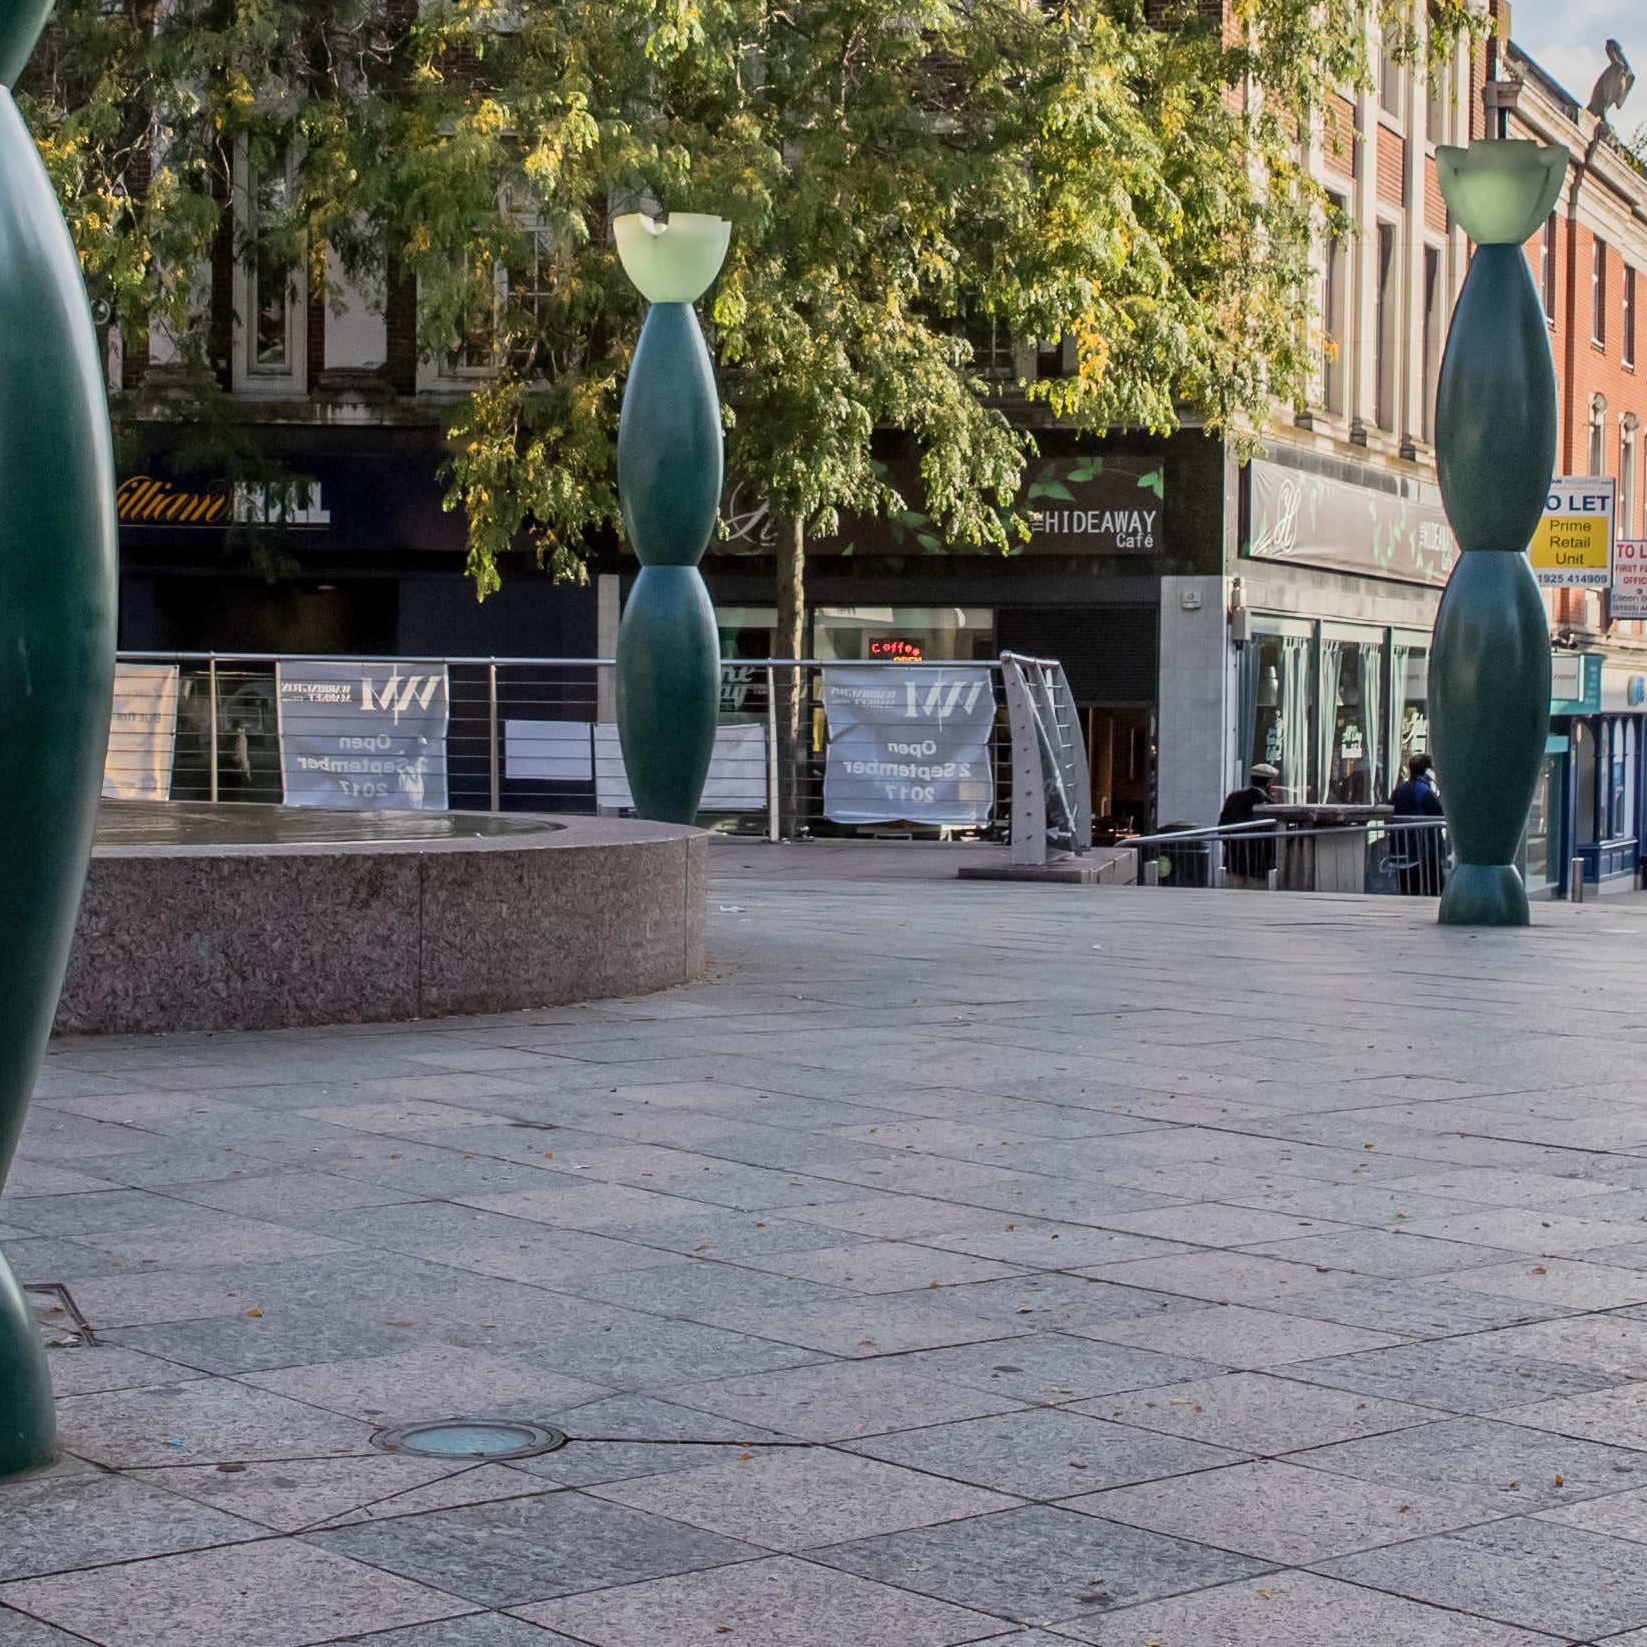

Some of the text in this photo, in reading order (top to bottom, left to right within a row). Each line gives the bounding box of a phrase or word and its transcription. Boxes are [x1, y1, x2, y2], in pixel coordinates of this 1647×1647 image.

[117, 475, 331, 524] illiam HILL
[1544, 495, 1610, 511] O LET
[1045, 510, 1156, 533] HIDEAWAY
[1549, 519, 1592, 532] Prime
[1116, 532, 1154, 548] Café
[1549, 535, 1591, 549] Retail
[1555, 553, 1584, 565] Unit
[1617, 544, 1635, 559] TO
[1616, 565, 1638, 573] FIRST
[1537, 575, 1564, 584] 1925
[871, 641, 921, 657] Coffee
